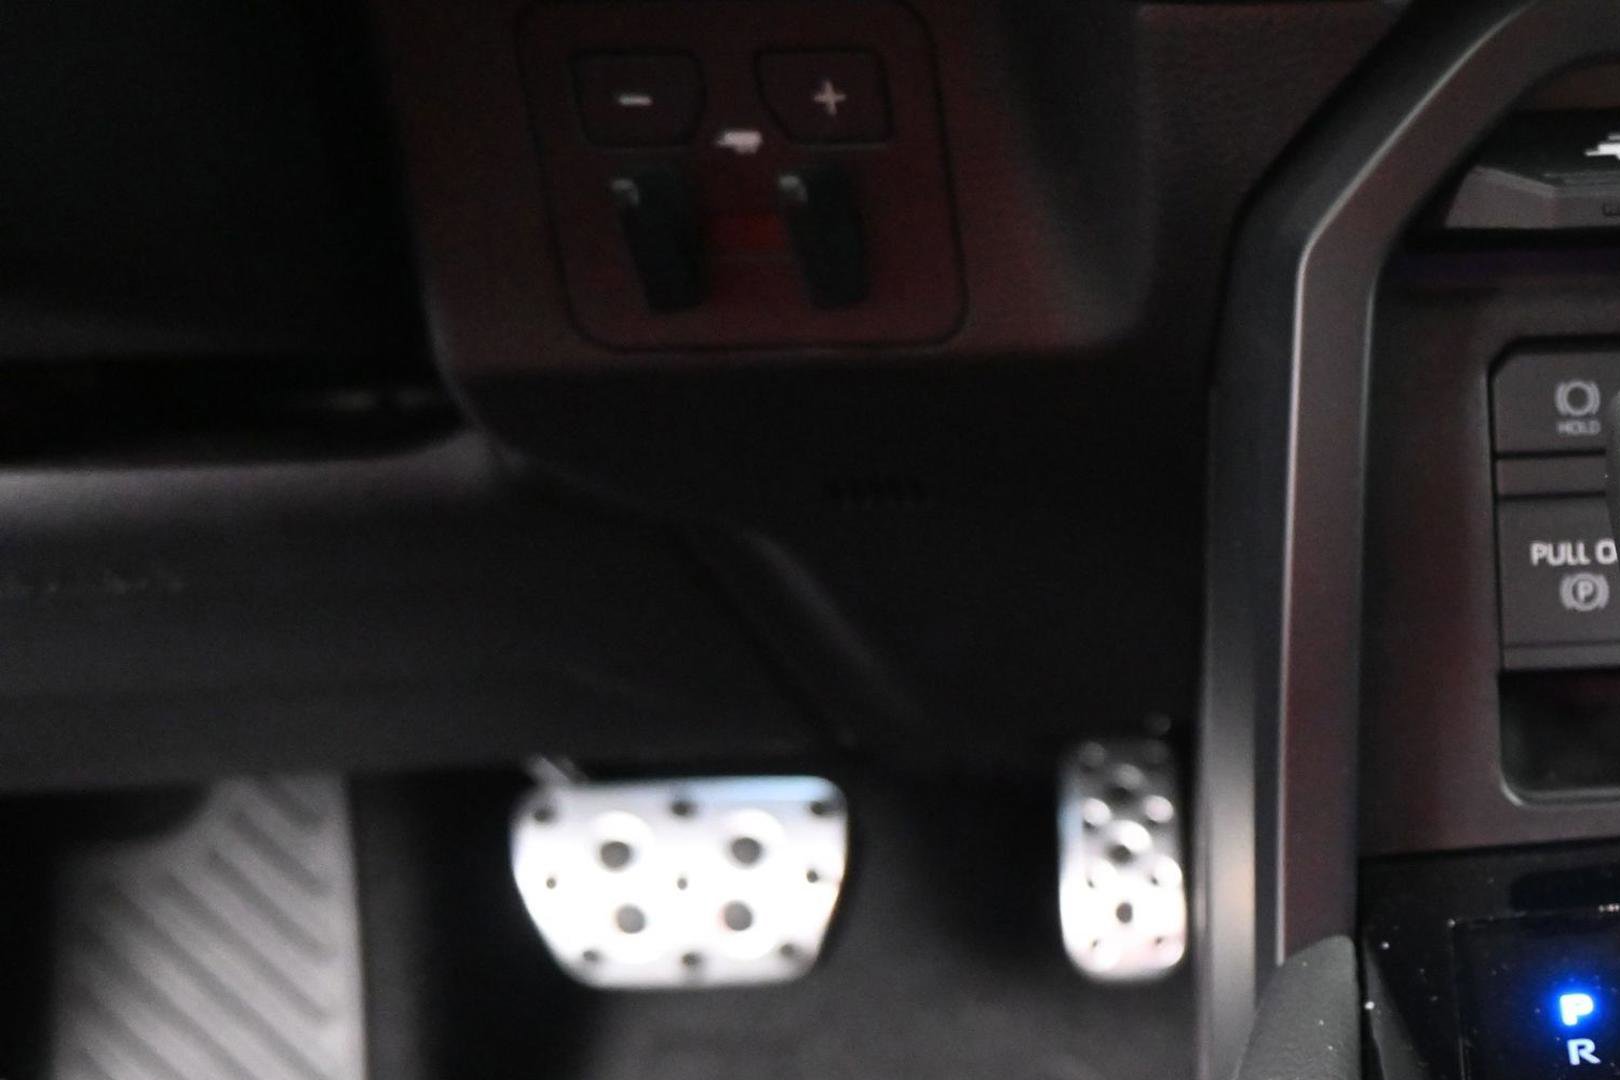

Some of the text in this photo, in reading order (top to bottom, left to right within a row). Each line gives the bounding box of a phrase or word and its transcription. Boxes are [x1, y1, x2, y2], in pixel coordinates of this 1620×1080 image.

[1557, 419, 1600, 435] HOLD
[1530, 541, 1590, 566] PULL
[1558, 993, 1595, 1026] P
[1567, 1038, 1600, 1065] R
